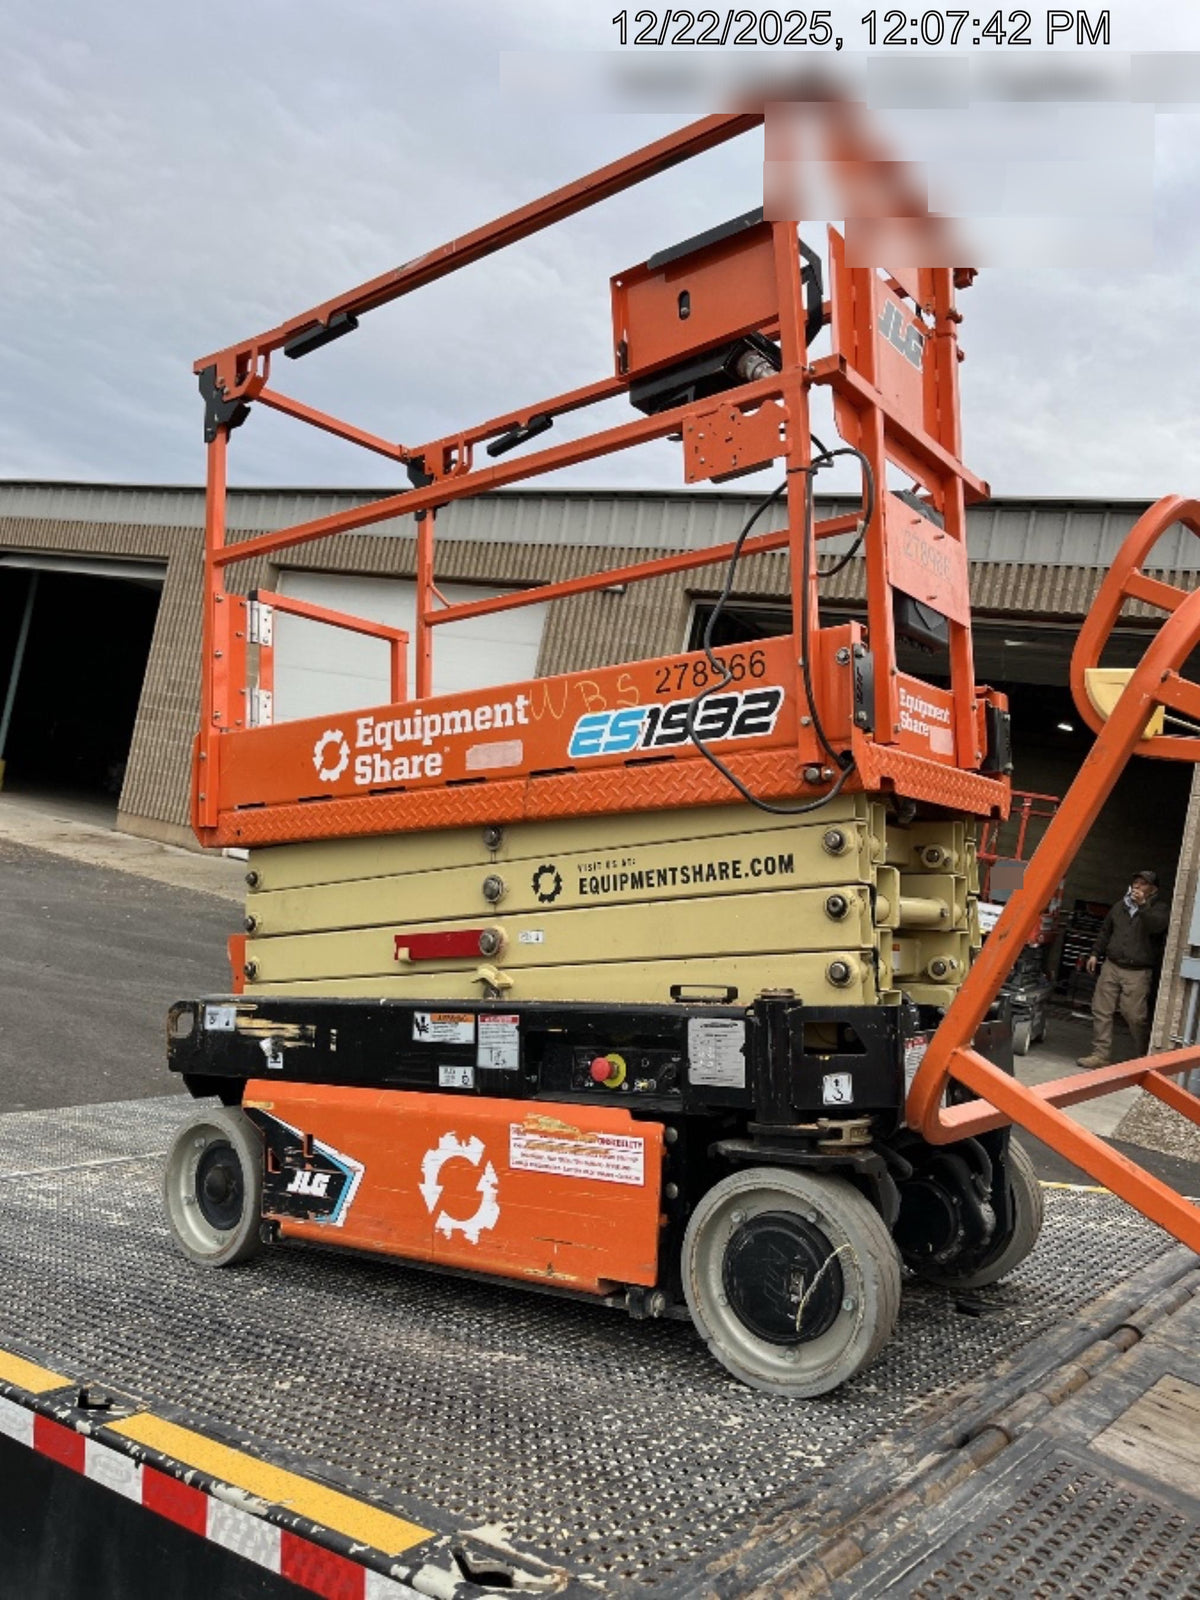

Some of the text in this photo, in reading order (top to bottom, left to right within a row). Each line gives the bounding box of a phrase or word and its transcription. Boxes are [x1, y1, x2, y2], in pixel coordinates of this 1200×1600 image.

[878, 298, 925, 374] JLG
[655, 650, 766, 694] 278966
[355, 695, 529, 752] Equipment
[569, 688, 783, 756] ES1932
[899, 687, 951, 725] Equipment
[899, 710, 930, 737] Share
[354, 752, 443, 785] Share
[578, 853, 795, 895] EQUIPMENTSHARE.COM
[286, 1170, 331, 1197] JLG
